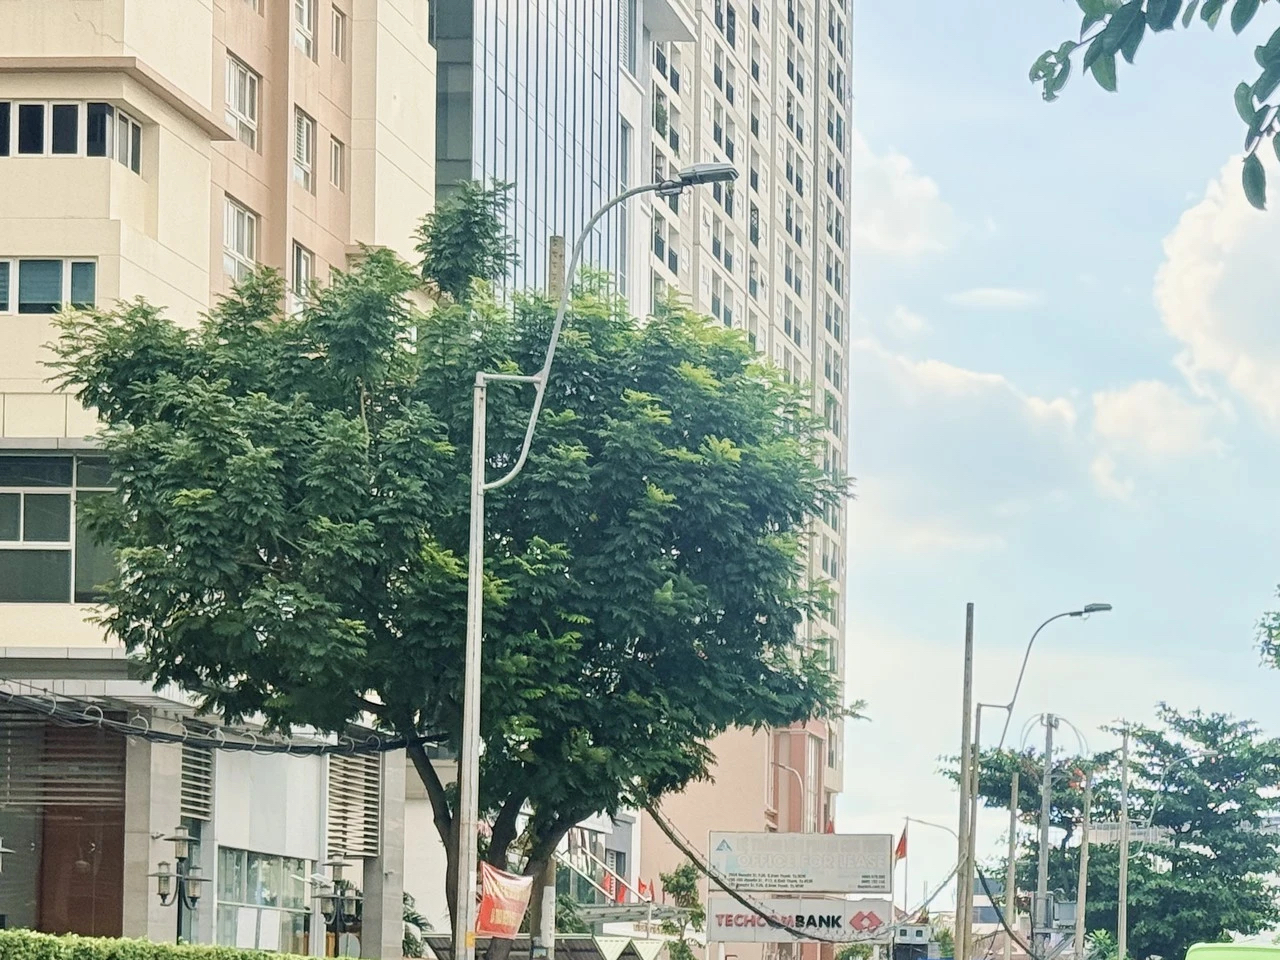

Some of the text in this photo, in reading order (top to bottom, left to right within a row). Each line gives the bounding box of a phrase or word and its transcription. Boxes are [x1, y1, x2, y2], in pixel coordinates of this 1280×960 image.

[737, 854, 885, 868] OFFICE FOR LEASE
